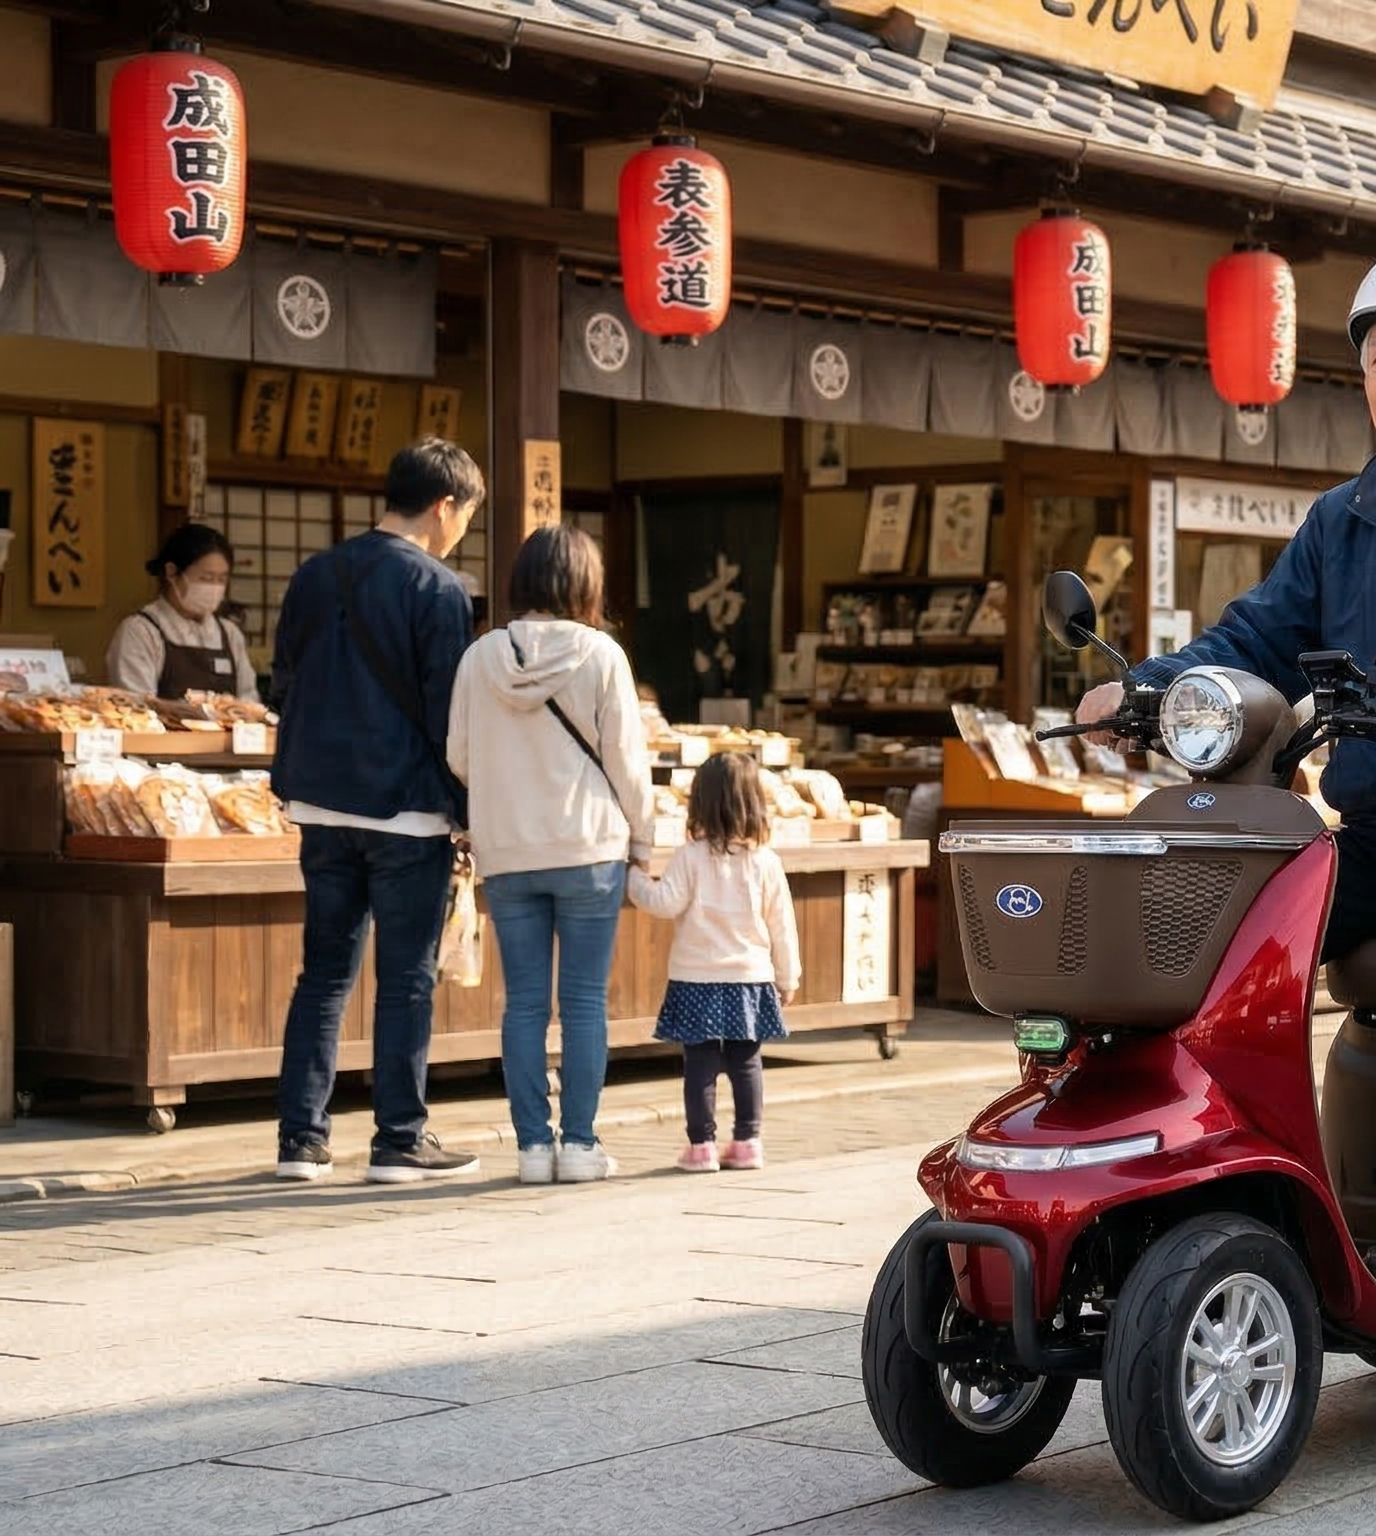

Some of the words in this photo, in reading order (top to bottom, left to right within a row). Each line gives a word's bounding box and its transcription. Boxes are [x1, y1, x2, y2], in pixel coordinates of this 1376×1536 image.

[166, 73, 230, 243] 成田山
[657, 159, 712, 310] 表参道
[1072, 231, 1107, 359] 成田山
